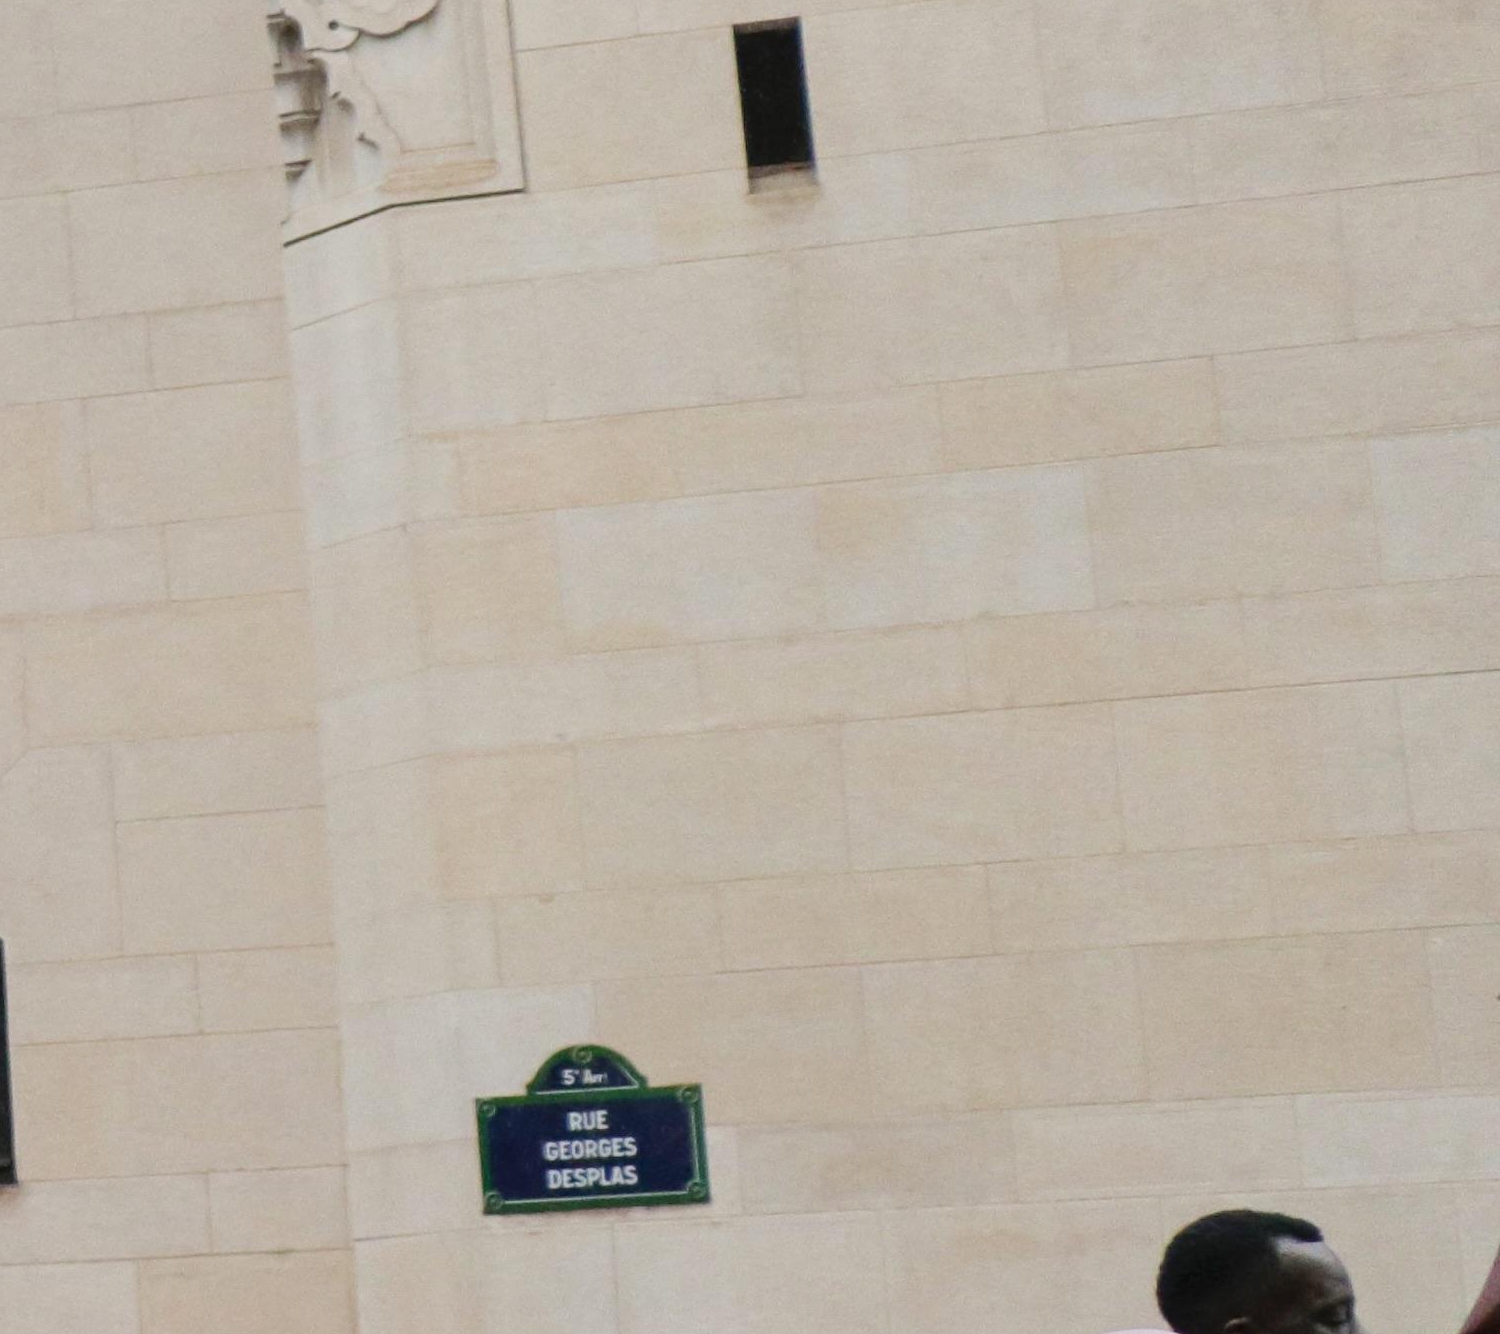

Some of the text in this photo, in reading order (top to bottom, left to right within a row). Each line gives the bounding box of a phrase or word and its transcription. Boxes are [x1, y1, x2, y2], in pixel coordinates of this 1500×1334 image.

[567, 1110, 609, 1131] RUE
[544, 1137, 638, 1161] GEORGES
[546, 1165, 639, 1189] DESPLAS
